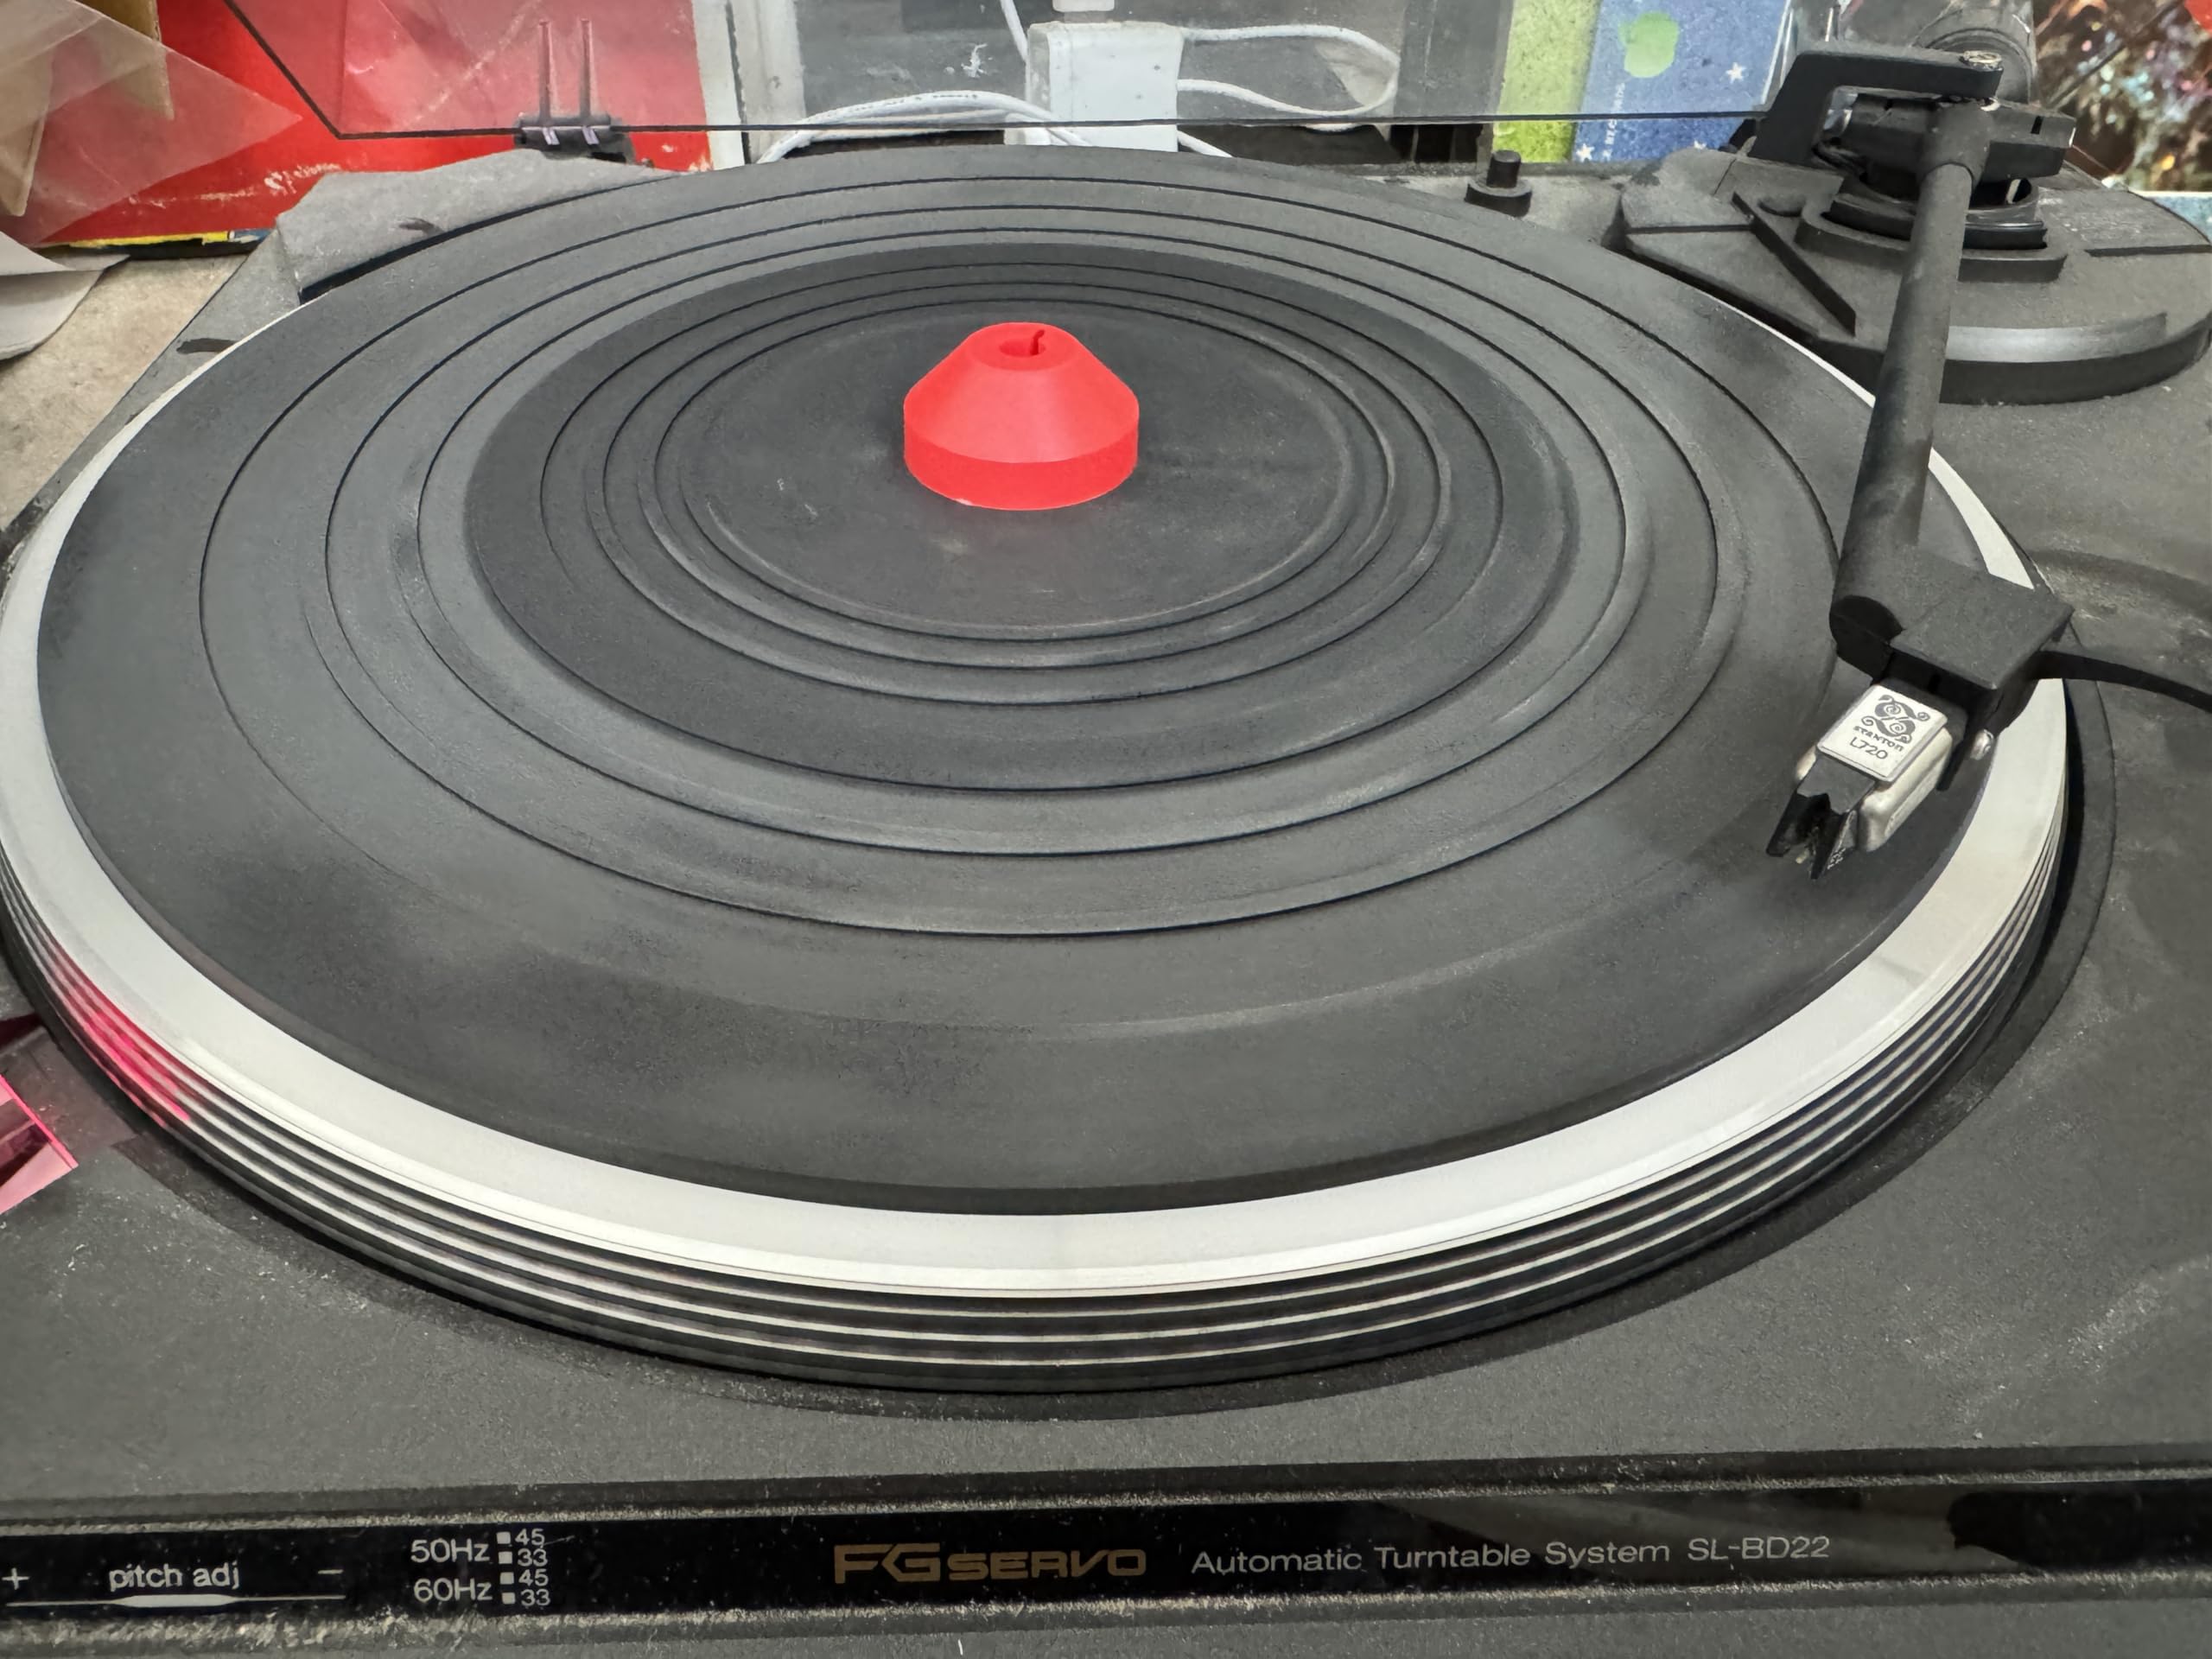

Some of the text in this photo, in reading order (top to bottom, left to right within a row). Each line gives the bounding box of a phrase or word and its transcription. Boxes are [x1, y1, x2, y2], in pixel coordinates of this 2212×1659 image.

[515, 1529, 545, 1545] 45
[411, 1538, 490, 1562] 50Hz
[518, 1548, 548, 1567] 33
[1192, 1536, 1830, 1575] Automatic Turntable System SL-BD22
[109, 1563, 182, 1590] pitch
[194, 1561, 240, 1589] adj
[518, 1568, 549, 1586] 45
[414, 1578, 493, 1602] 60Hz
[520, 1588, 550, 1606] 33
